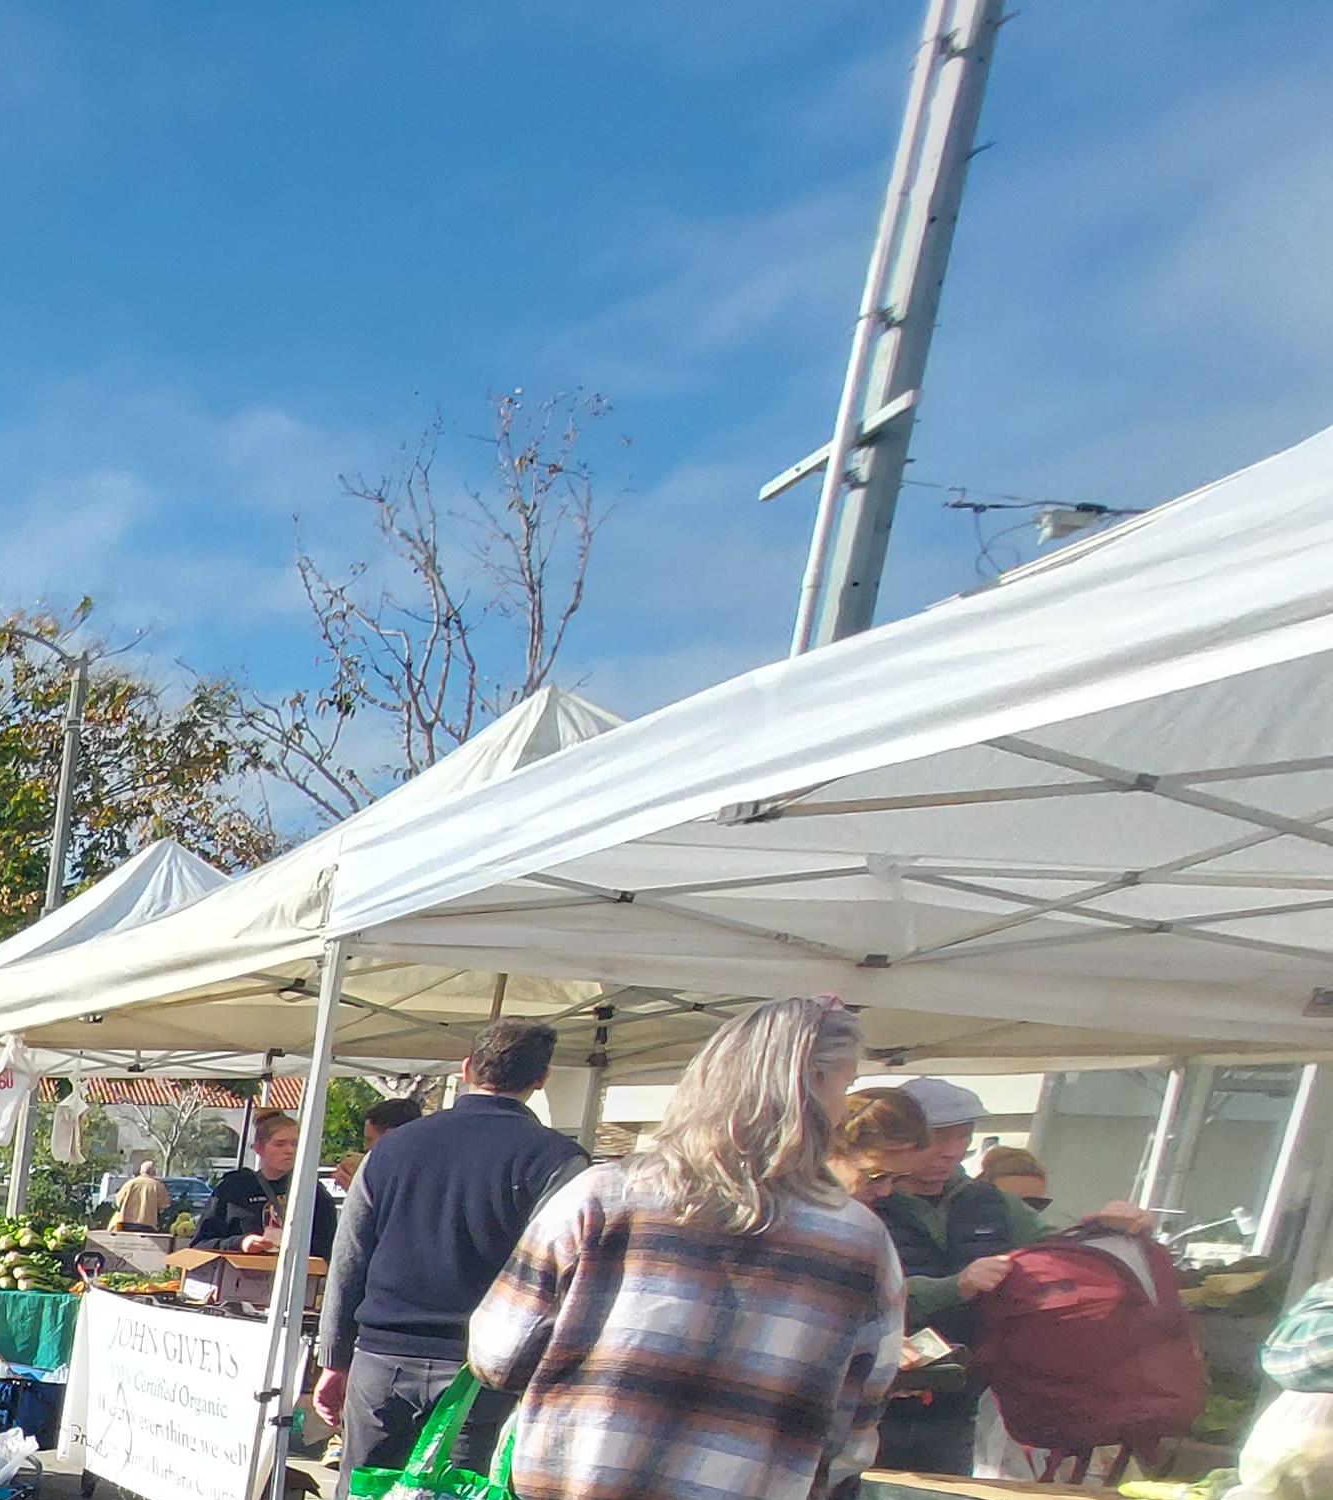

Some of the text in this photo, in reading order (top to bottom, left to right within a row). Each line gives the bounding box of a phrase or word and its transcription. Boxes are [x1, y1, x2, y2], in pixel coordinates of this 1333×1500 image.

[108, 1317, 239, 1379] JOHN GIVENS
[134, 1372, 177, 1404] Certified
[179, 1385, 228, 1418] Organic
[139, 1413, 197, 1453] everything
[200, 1436, 219, 1459] we
[224, 1441, 248, 1467] sell
